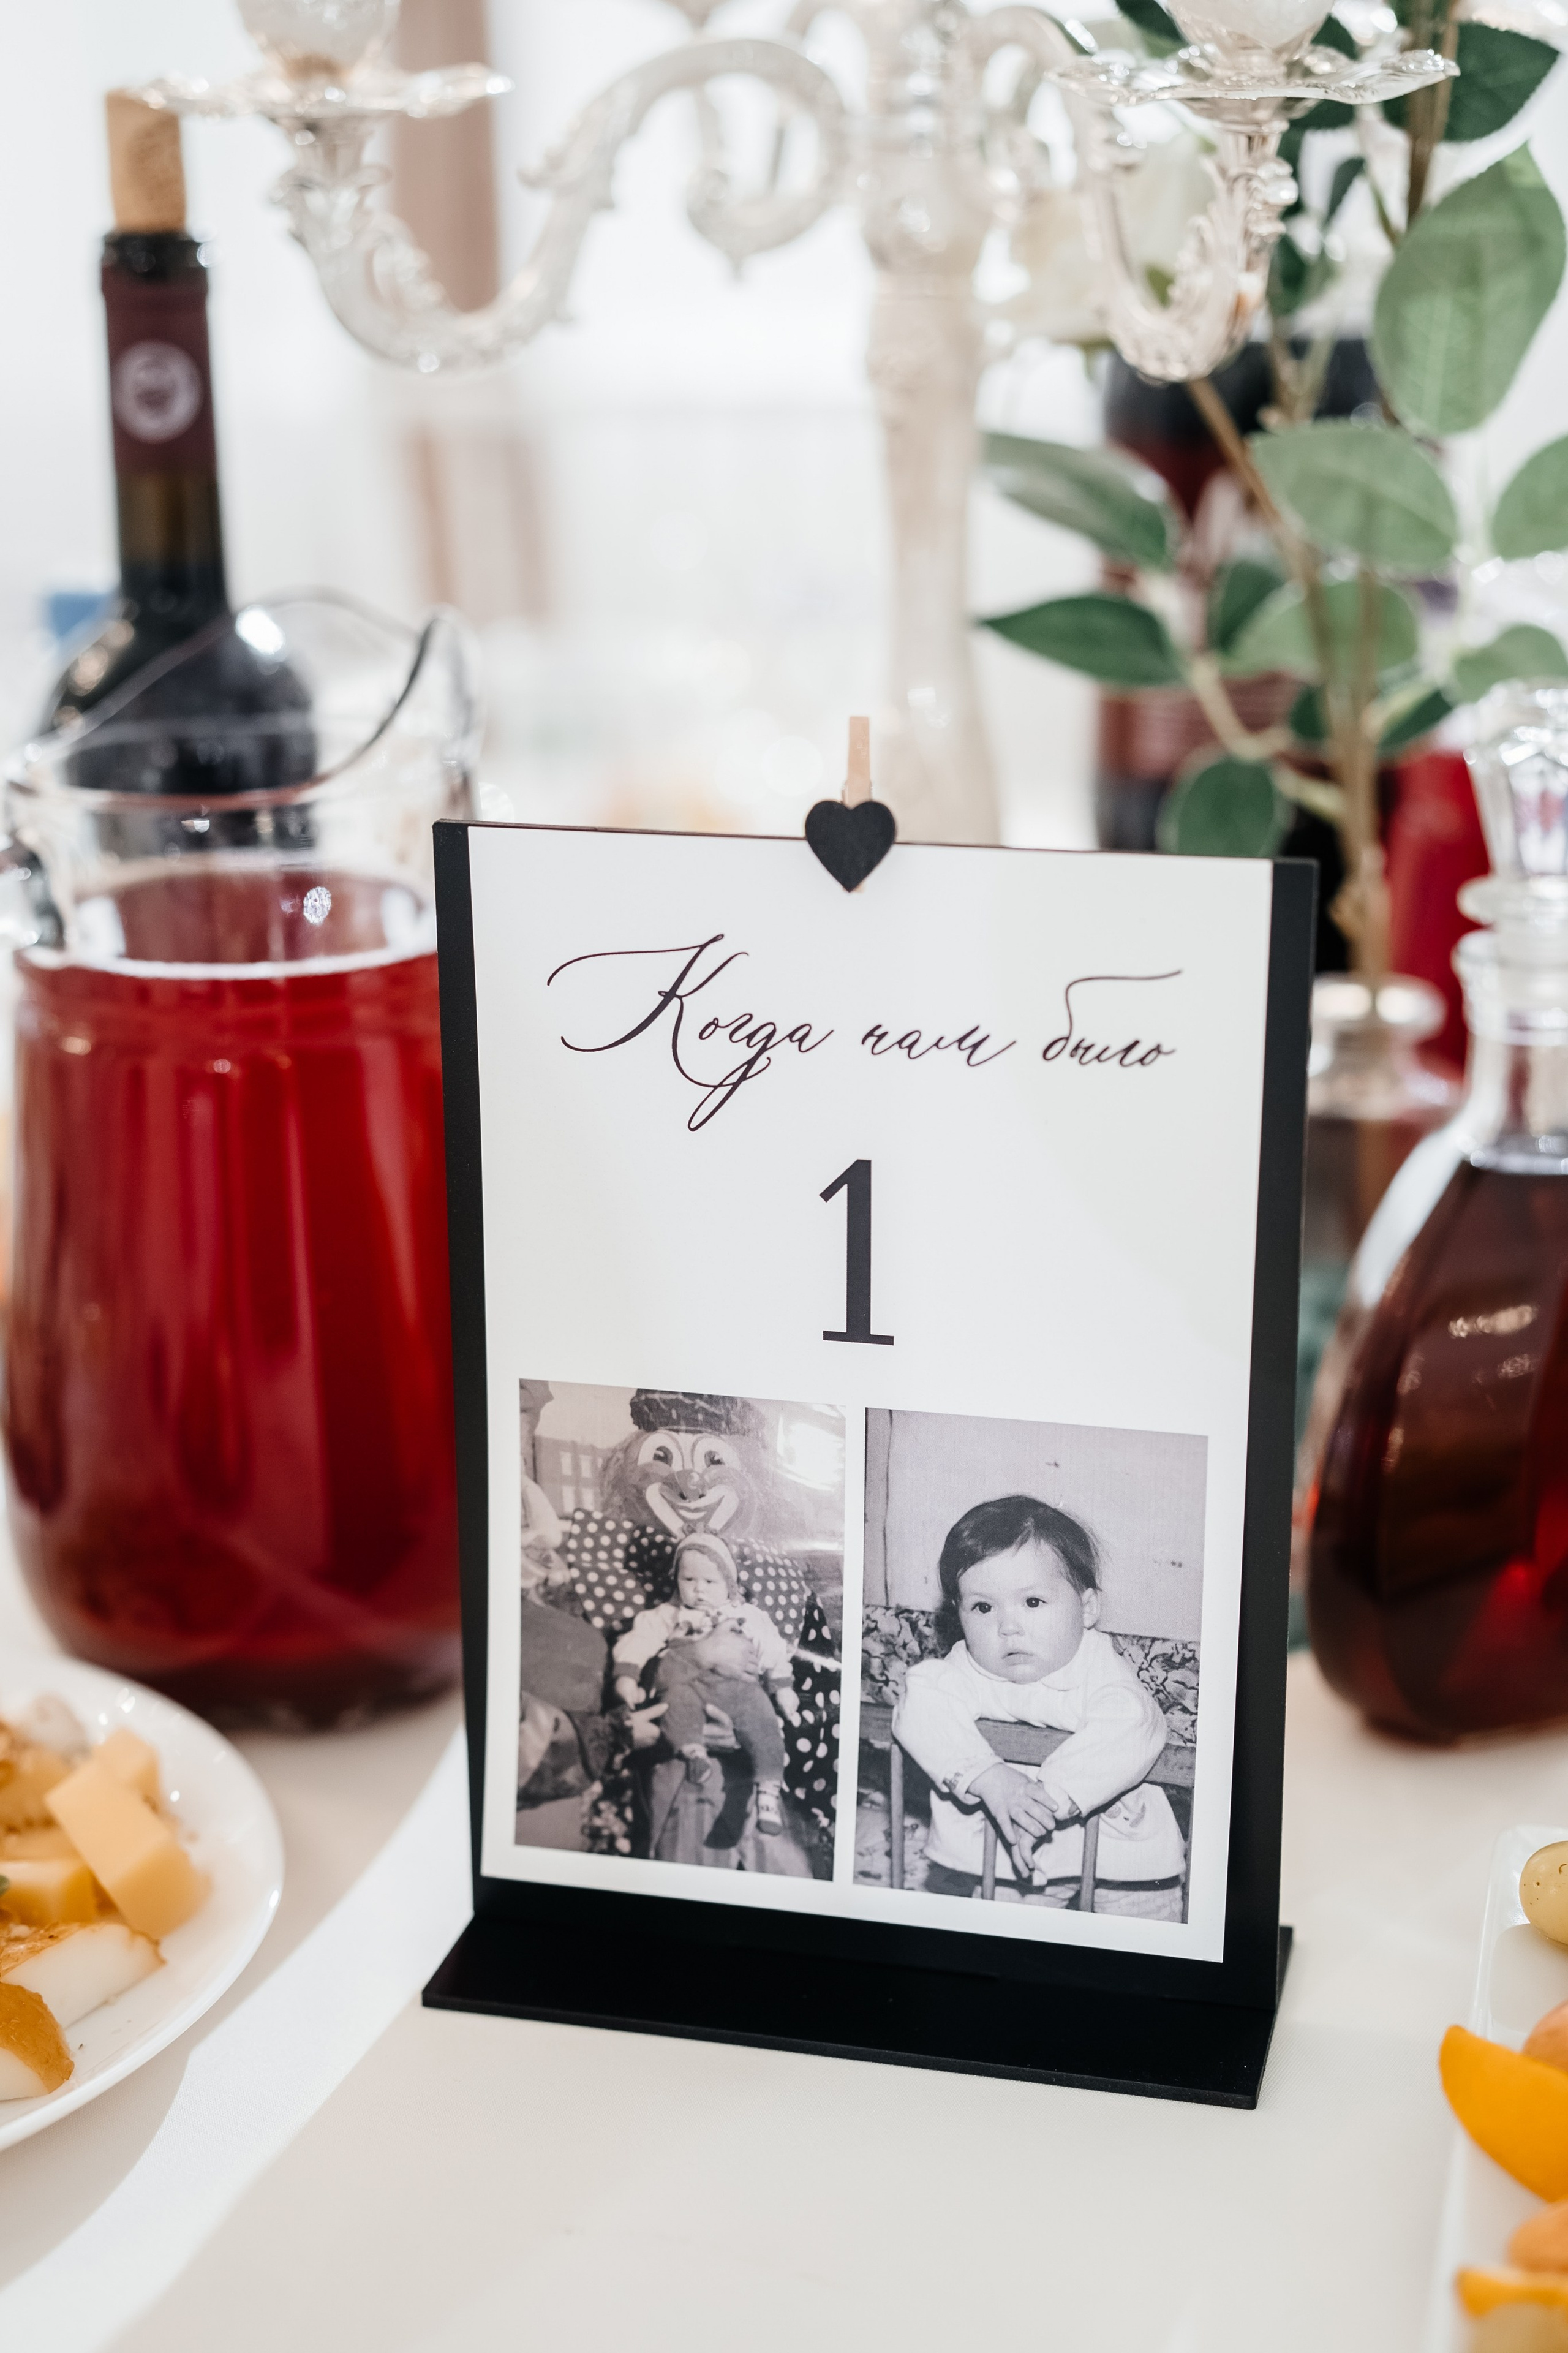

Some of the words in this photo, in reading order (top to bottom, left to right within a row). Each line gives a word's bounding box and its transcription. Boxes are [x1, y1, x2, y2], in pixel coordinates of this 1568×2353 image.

[546, 934, 834, 1132] Когда
[861, 1024, 1016, 1067] нам
[1042, 969, 1183, 1067] было
[819, 1159, 894, 1346] 1
